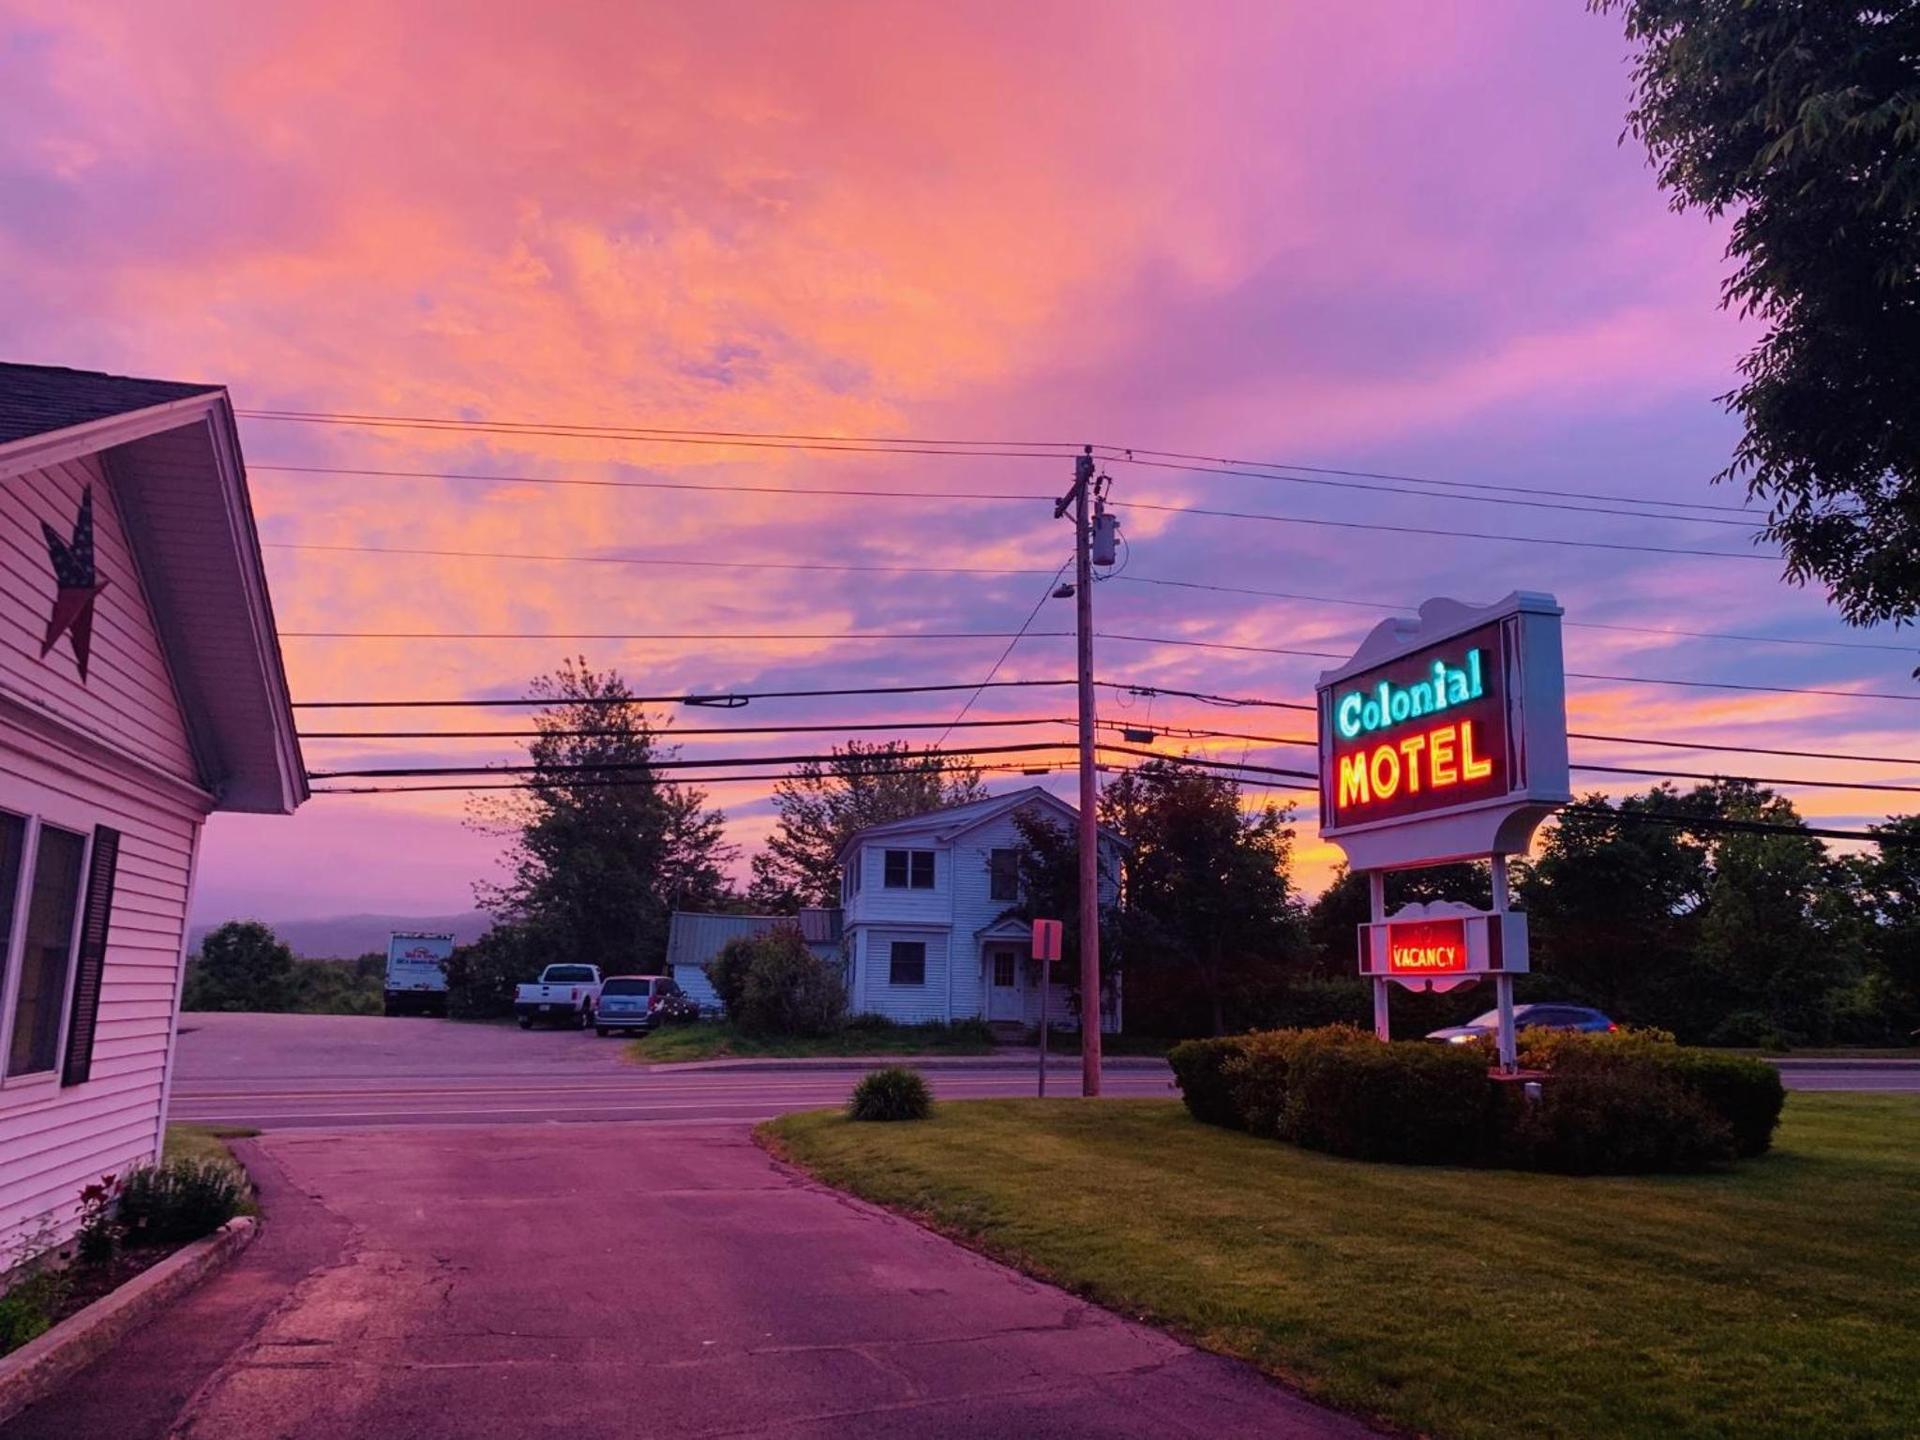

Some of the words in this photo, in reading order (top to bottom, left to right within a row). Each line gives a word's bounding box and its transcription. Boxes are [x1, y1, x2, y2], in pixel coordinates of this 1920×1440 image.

[1339, 649, 1483, 737] Colonial
[1339, 720, 1492, 808] MOTEL
[1393, 946, 1455, 967] VACANCY
